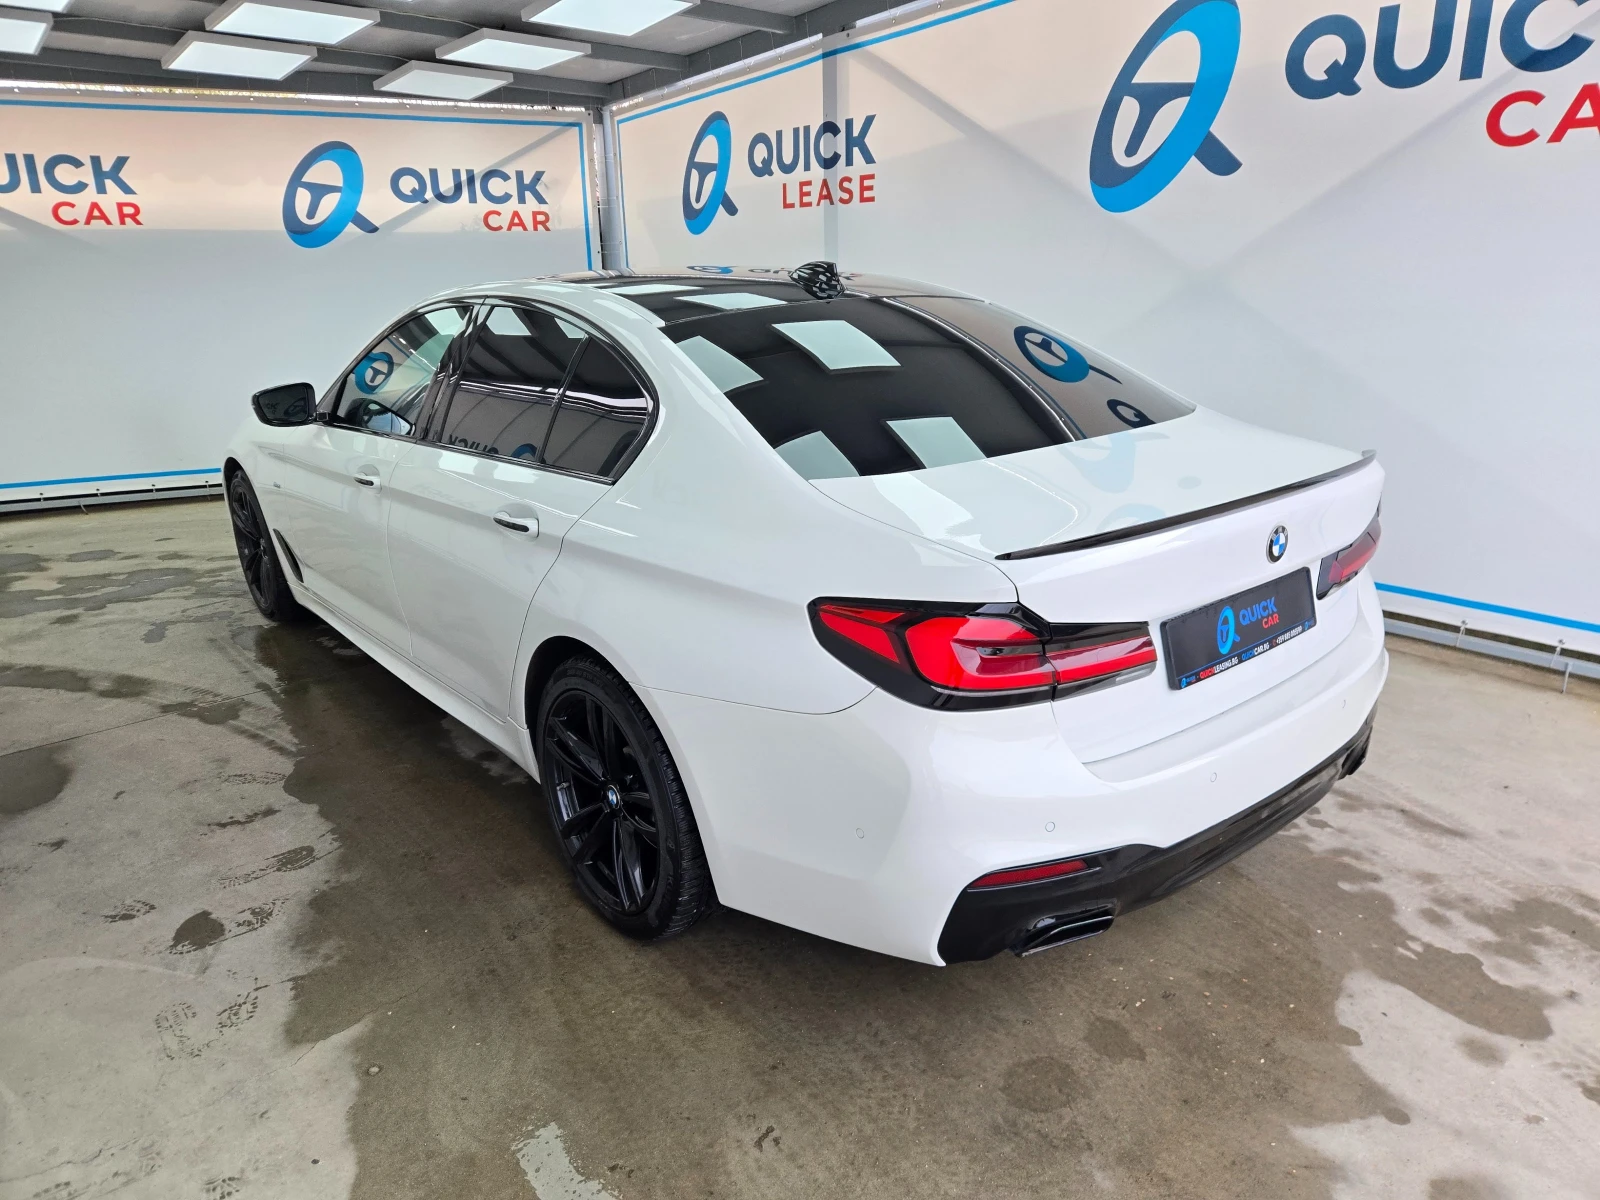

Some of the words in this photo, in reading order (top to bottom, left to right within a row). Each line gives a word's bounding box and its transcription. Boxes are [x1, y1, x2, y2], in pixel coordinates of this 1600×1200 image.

[1486, 82, 1600, 147] CA
[747, 114, 877, 178] QUICK
[390, 167, 549, 204] QUICK
[782, 173, 875, 209] LEASE
[51, 201, 144, 226] CAR
[482, 210, 551, 231] CAR
[1239, 597, 1277, 626] QUICK
[1262, 613, 1279, 629] CAR
